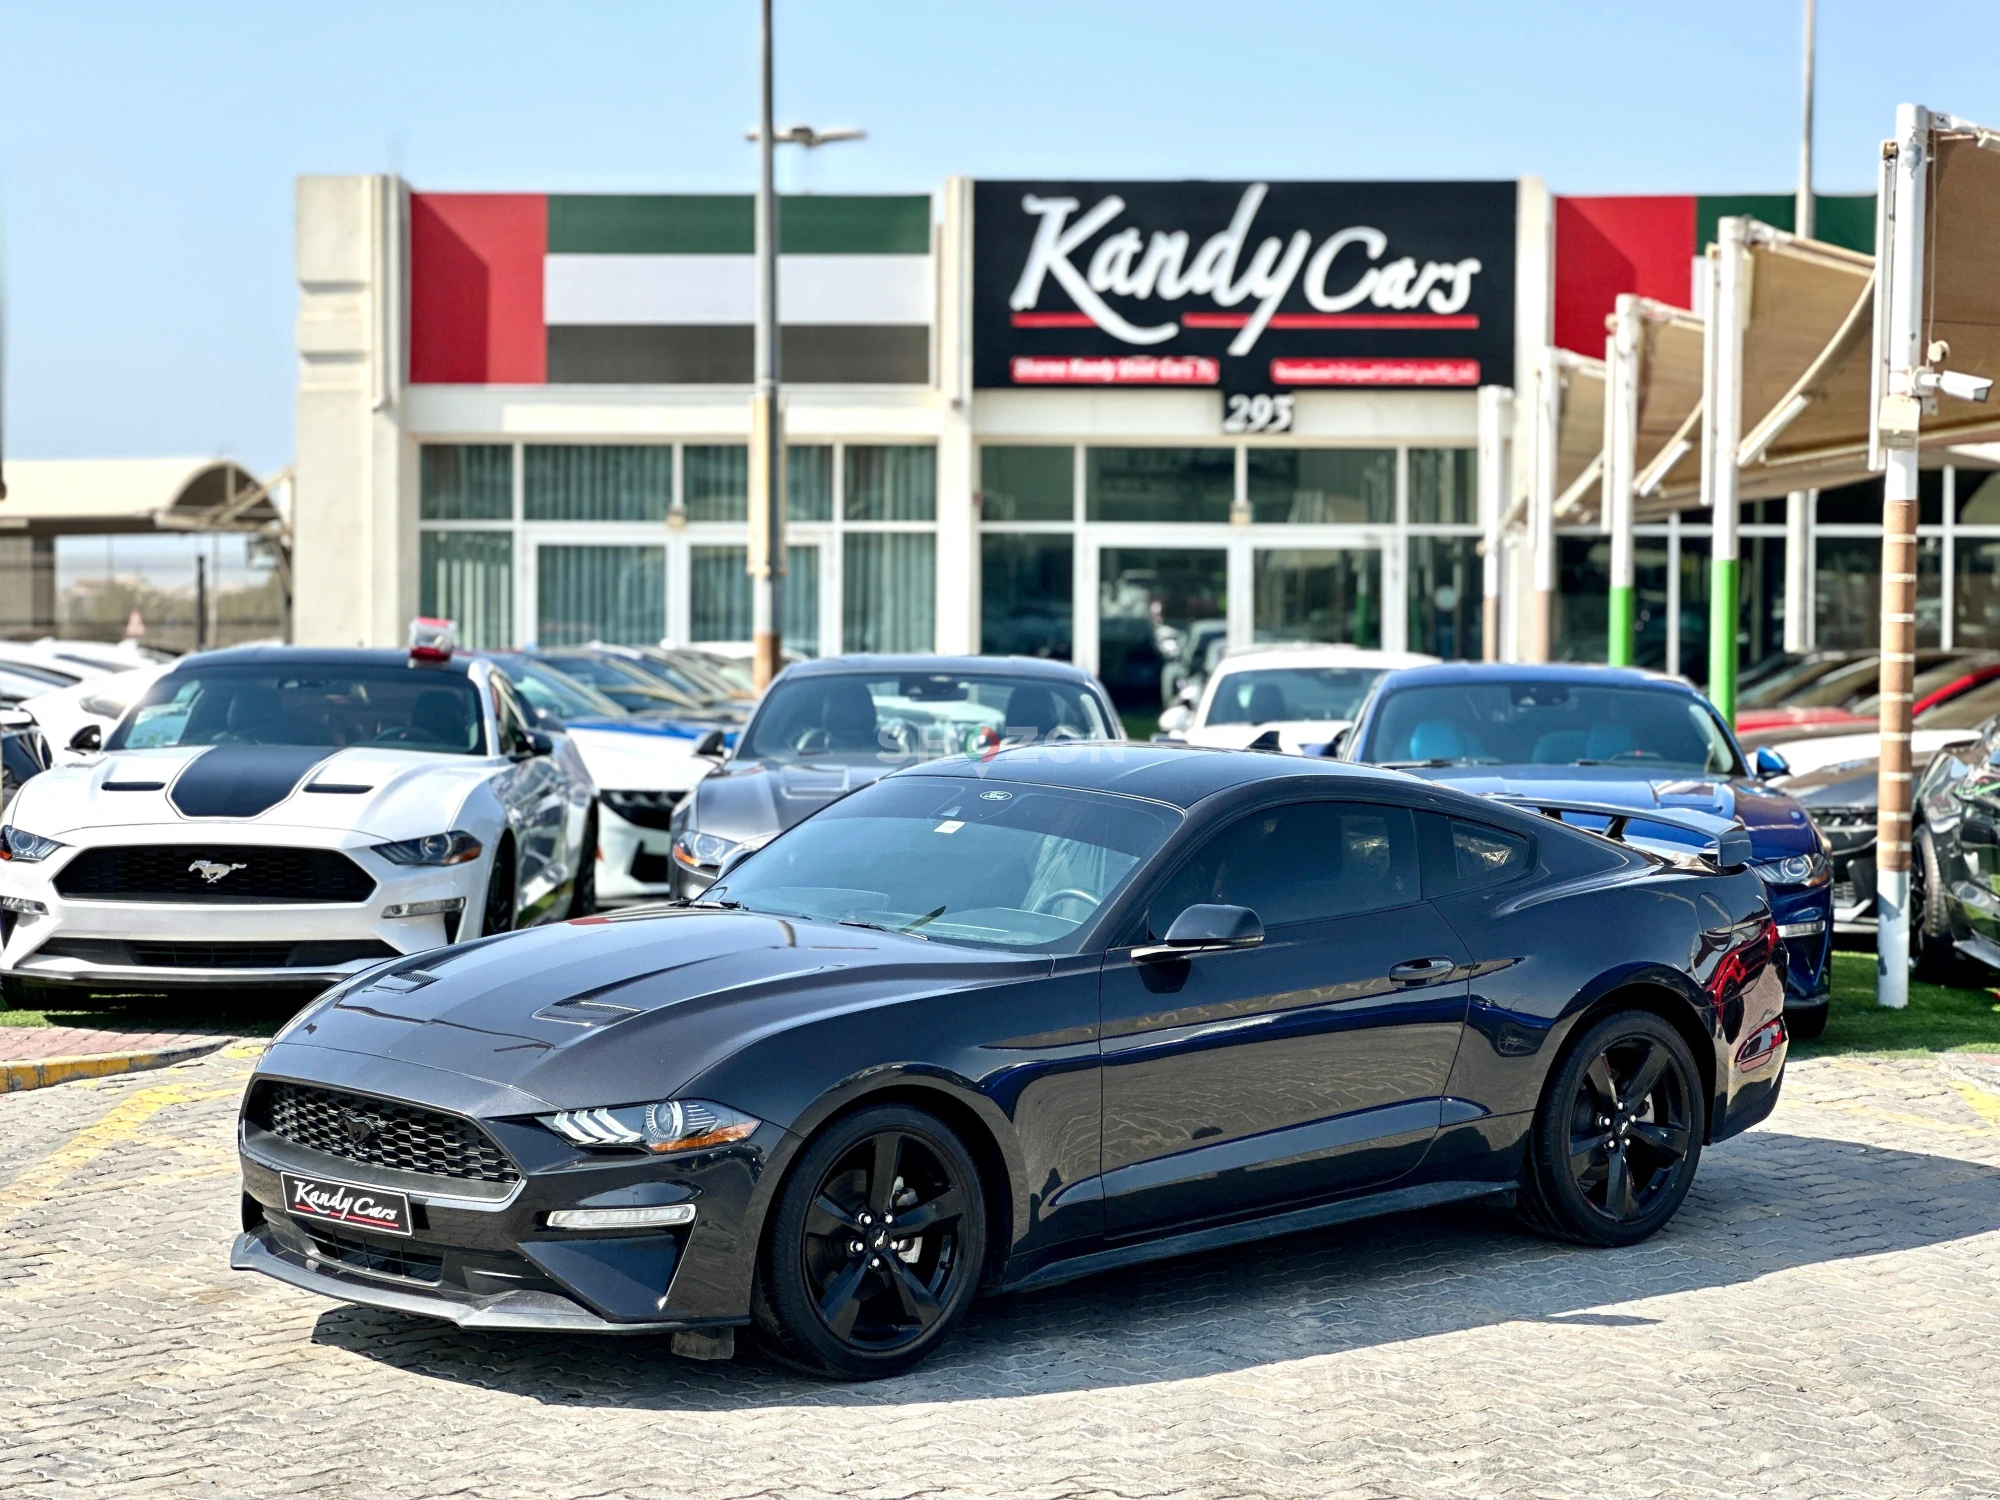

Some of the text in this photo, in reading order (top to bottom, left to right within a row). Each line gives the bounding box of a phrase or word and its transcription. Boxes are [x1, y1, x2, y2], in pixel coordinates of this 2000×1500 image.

[1009, 182, 1481, 356] Kandy Cars
[1222, 393, 1296, 433] 295
[294, 1181, 398, 1220] Kandy Cars
